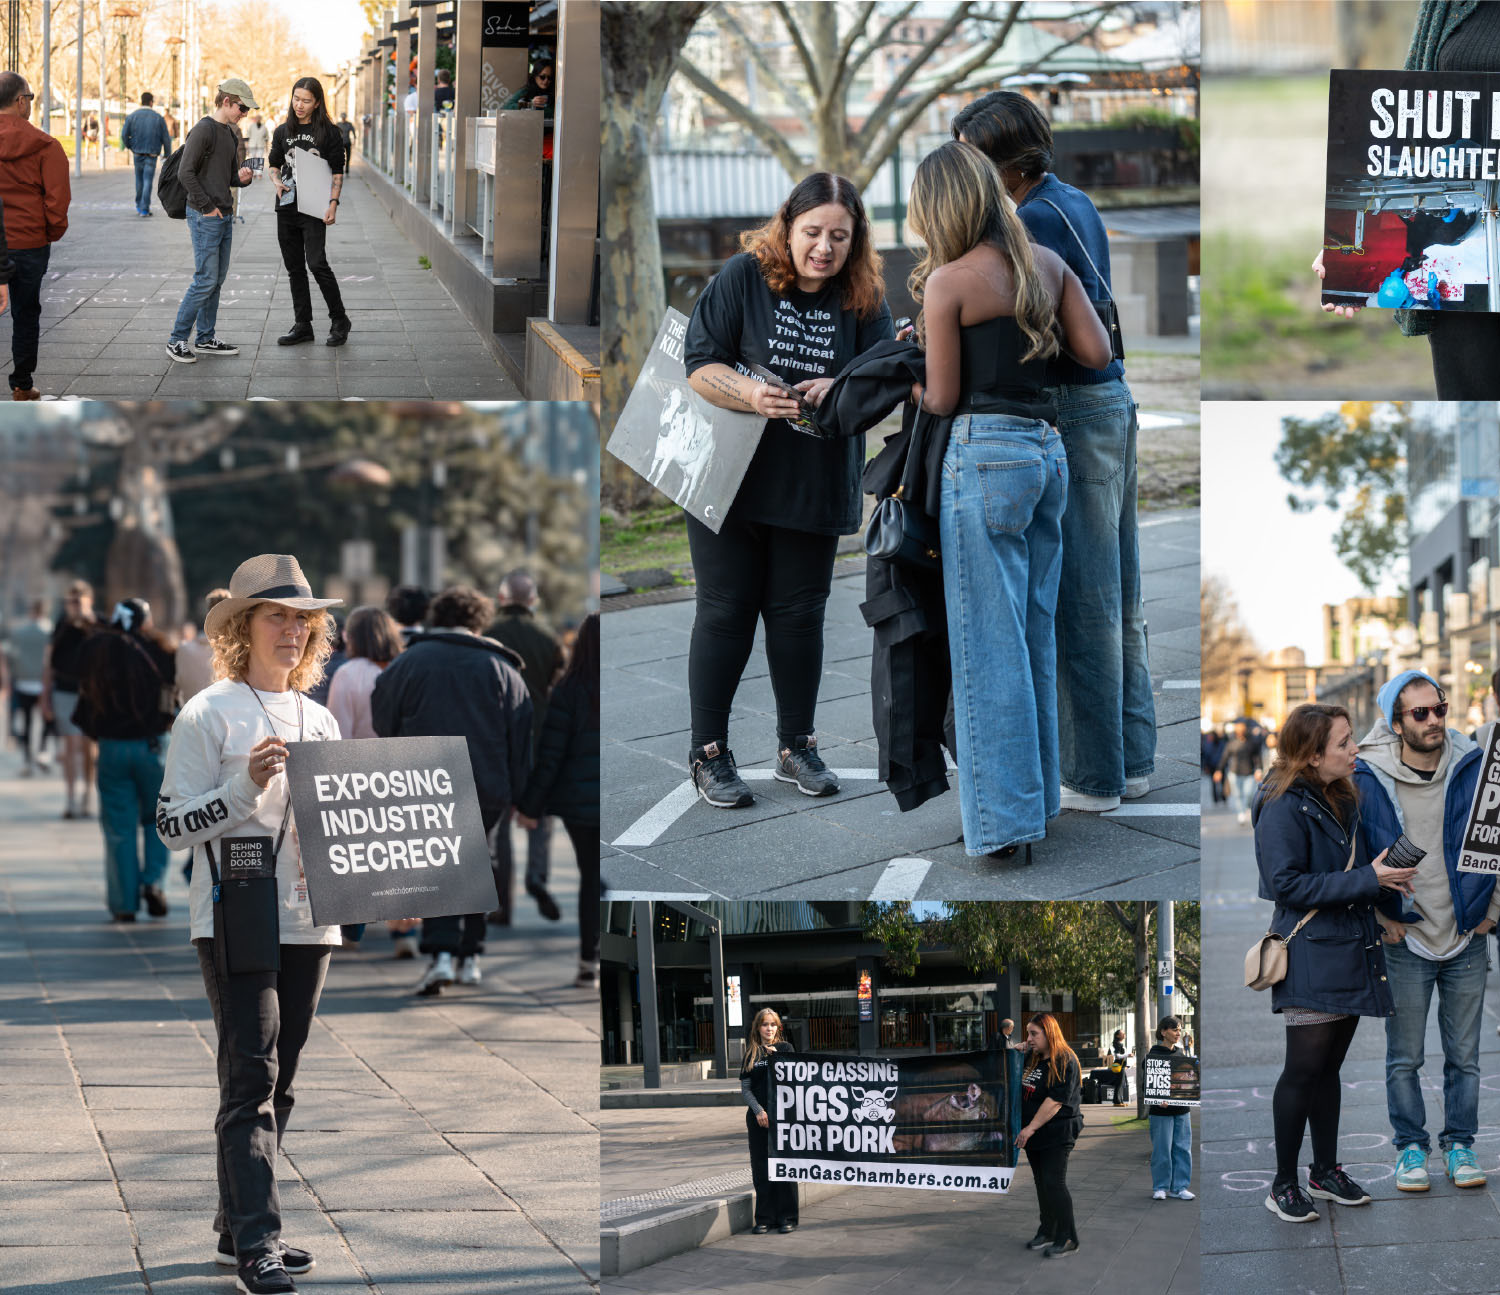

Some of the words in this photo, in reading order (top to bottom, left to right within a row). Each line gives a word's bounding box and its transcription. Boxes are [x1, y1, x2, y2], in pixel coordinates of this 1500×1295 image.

[1369, 88, 1481, 139] SHUT
[774, 309, 806, 331] Treat
[809, 325, 836, 333] You
[805, 309, 832, 321] Life
[667, 319, 686, 340] THE
[775, 324, 799, 338] The
[659, 334, 682, 361] KILL
[767, 338, 795, 352] You
[797, 343, 835, 360] Treat
[769, 354, 826, 374] Animals
[314, 768, 453, 802] EXPOSING
[184, 798, 228, 833] END
[320, 802, 456, 837] INDUSTRY
[1471, 823, 1500, 845] FOR
[230, 843, 262, 851] BEHIND
[230, 850, 262, 859] CLOSED
[328, 835, 462, 875] SECRECY
[230, 858, 262, 867] DOORS
[774, 1061, 819, 1082] STOP
[821, 1062, 899, 1082] GASSING
[1146, 1058, 1163, 1067] STOP
[1146, 1067, 1172, 1075] GASSING
[1145, 1075, 1172, 1089] PIGS
[776, 1084, 849, 1123] PIGS
[1156, 1089, 1171, 1097] PORK
[776, 1122, 822, 1151] FOR
[826, 1124, 897, 1154] PORK
[775, 1162, 1010, 1190] BanGasChambers.com.au
